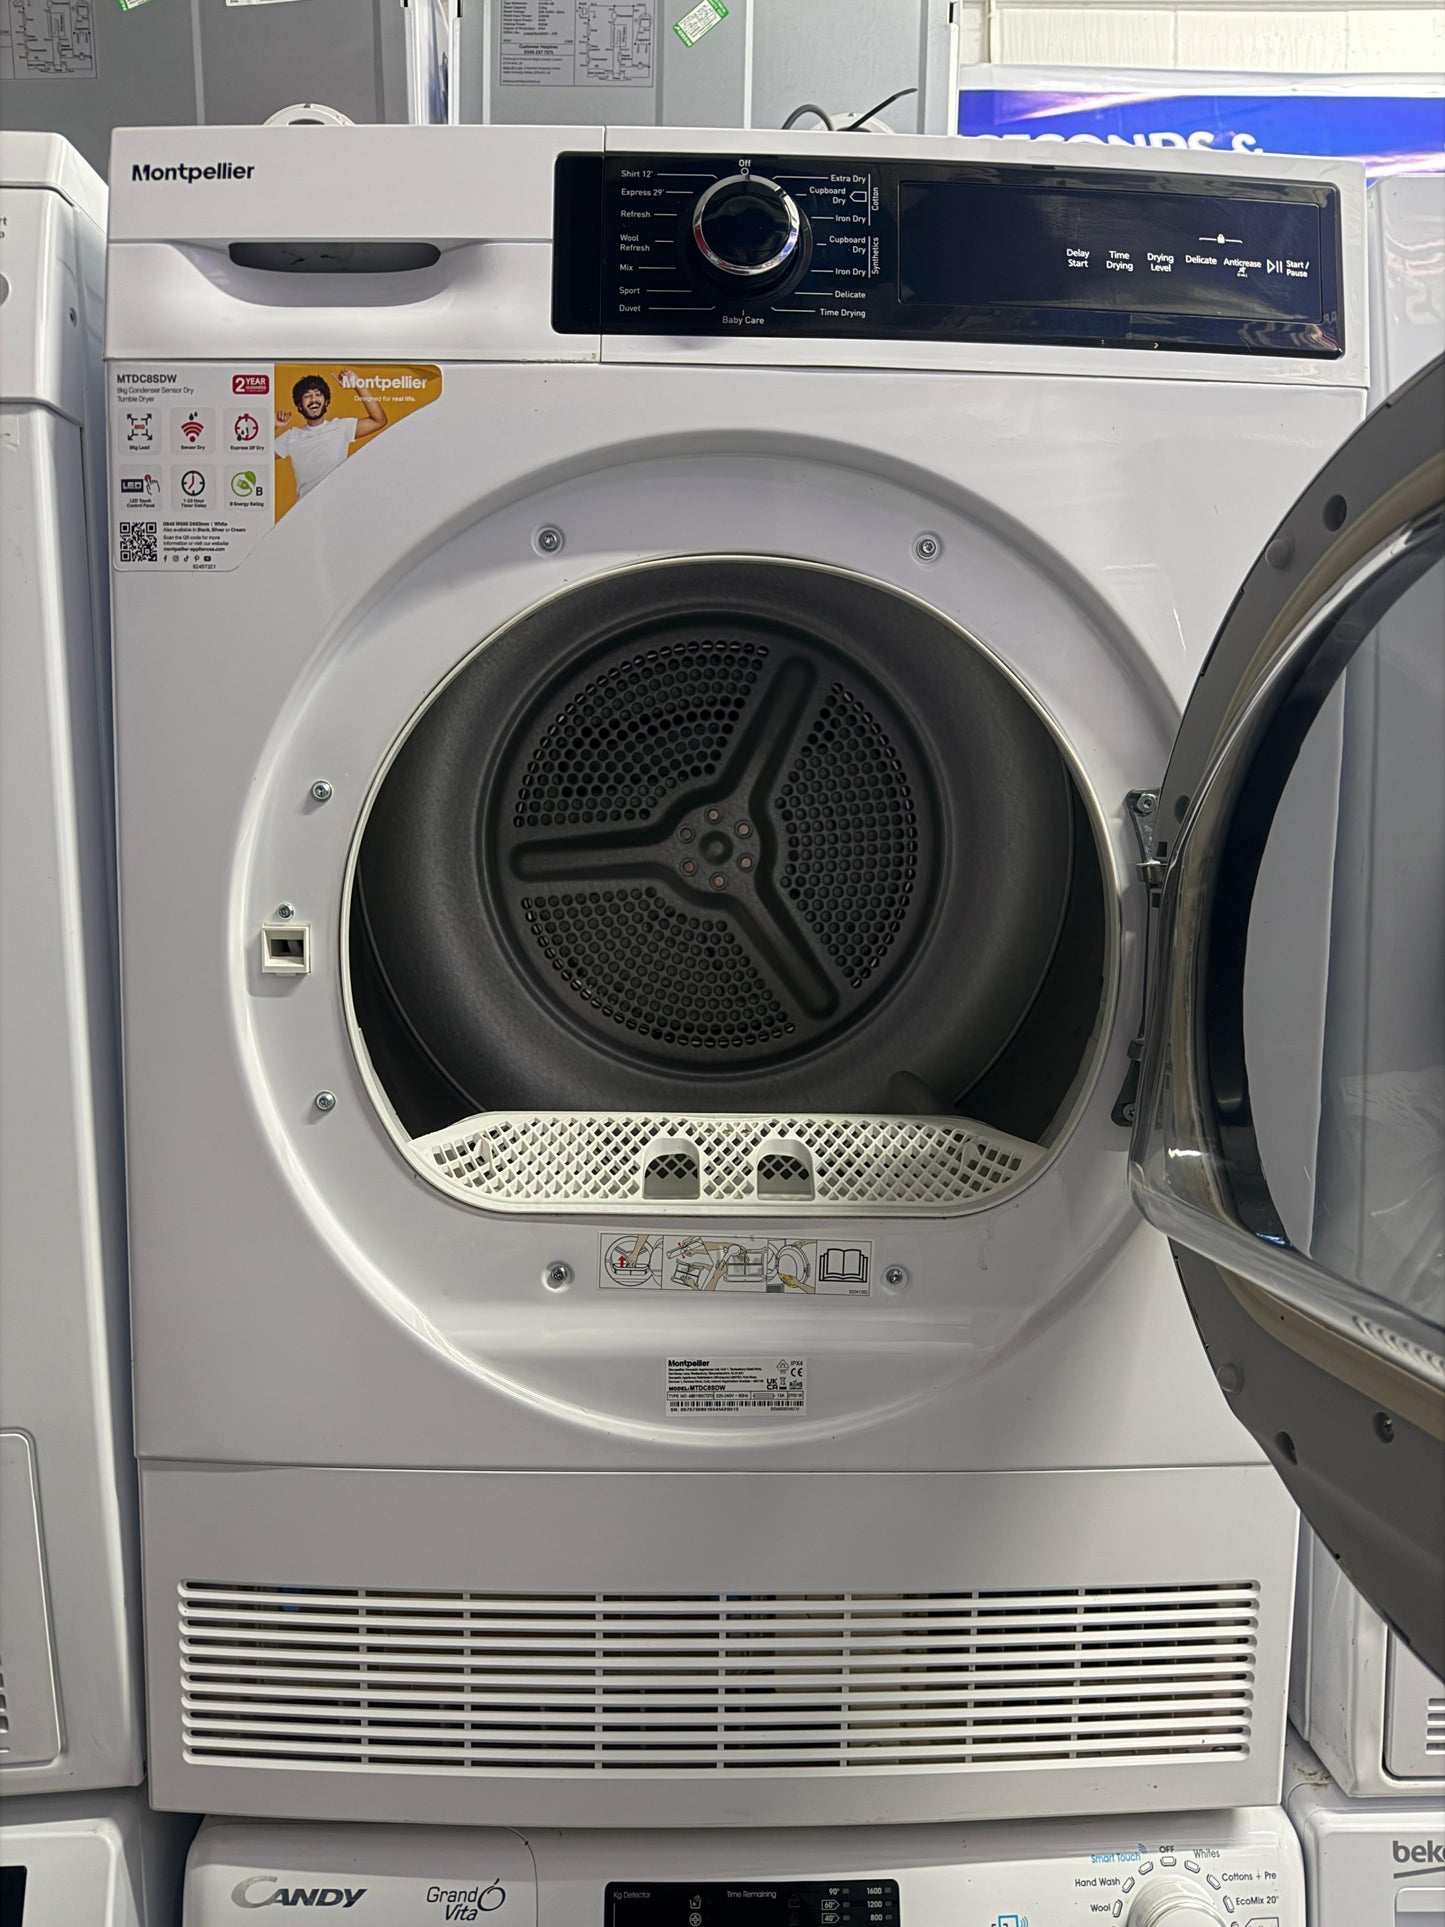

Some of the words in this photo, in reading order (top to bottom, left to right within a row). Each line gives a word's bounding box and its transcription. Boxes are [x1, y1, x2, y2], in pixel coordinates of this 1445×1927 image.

[738, 159, 751, 167] Off
[131, 163, 255, 183] Montpellier
[621, 170, 640, 178] Shirt
[831, 174, 851, 182] Extra
[853, 175, 866, 184] Dry
[621, 188, 651, 197] Express
[809, 187, 846, 195] Cupboard
[833, 197, 846, 205] Dry
[871, 187, 879, 211] Cotton
[621, 210, 650, 218] Refresh
[853, 215, 866, 224] Dry
[620, 234, 639, 242] Wool
[829, 235, 866, 244] Cupboard
[853, 246, 866, 255] Dry
[1066, 248, 1089, 259] Delay
[1109, 250, 1129, 260] Time
[871, 237, 880, 275] Synthetics
[1147, 253, 1174, 264] Drying
[1185, 255, 1217, 265] Delicate
[1068, 259, 1088, 268] Start
[1106, 261, 1133, 272] Drying
[1151, 263, 1171, 272] Level
[1224, 258, 1262, 268] Anticrease
[853, 268, 866, 277] Dry
[1286, 268, 1308, 277] Pause
[619, 287, 640, 295] Sport
[820, 308, 839, 316] Time
[841, 309, 866, 318] Drying
[722, 316, 743, 325] Baby
[745, 316, 765, 325] Care
[117, 374, 177, 383] MTDC8SDW
[342, 375, 428, 391] Montpellier
[236, 377, 245, 392] 2
[245, 377, 266, 385] YEAR
[183, 387, 194, 395] Dry
[139, 395, 155, 404] Dryer
[122, 481, 142, 490] LED
[256, 486, 263, 496] B
[791, 1368, 803, 1377] CE
[1159, 1845, 1175, 1853] OFF
[1193, 1848, 1220, 1858] Whites
[1392, 1840, 1445, 1863] bek
[1090, 1854, 1115, 1863] Smart
[1117, 1852, 1140, 1862] Touch
[1222, 1873, 1253, 1881] Cottons
[1264, 1871, 1277, 1879] Pre
[1075, 1878, 1097, 1887] Hand
[1099, 1877, 1120, 1886] Wash
[231, 1875, 368, 1908] CANDY
[613, 1891, 622, 1900] Kg
[727, 1890, 741, 1898] Time
[743, 1890, 777, 1899] Remaining
[1236, 1897, 1264, 1905] EcoMix
[1090, 1904, 1111, 1912] Wool
